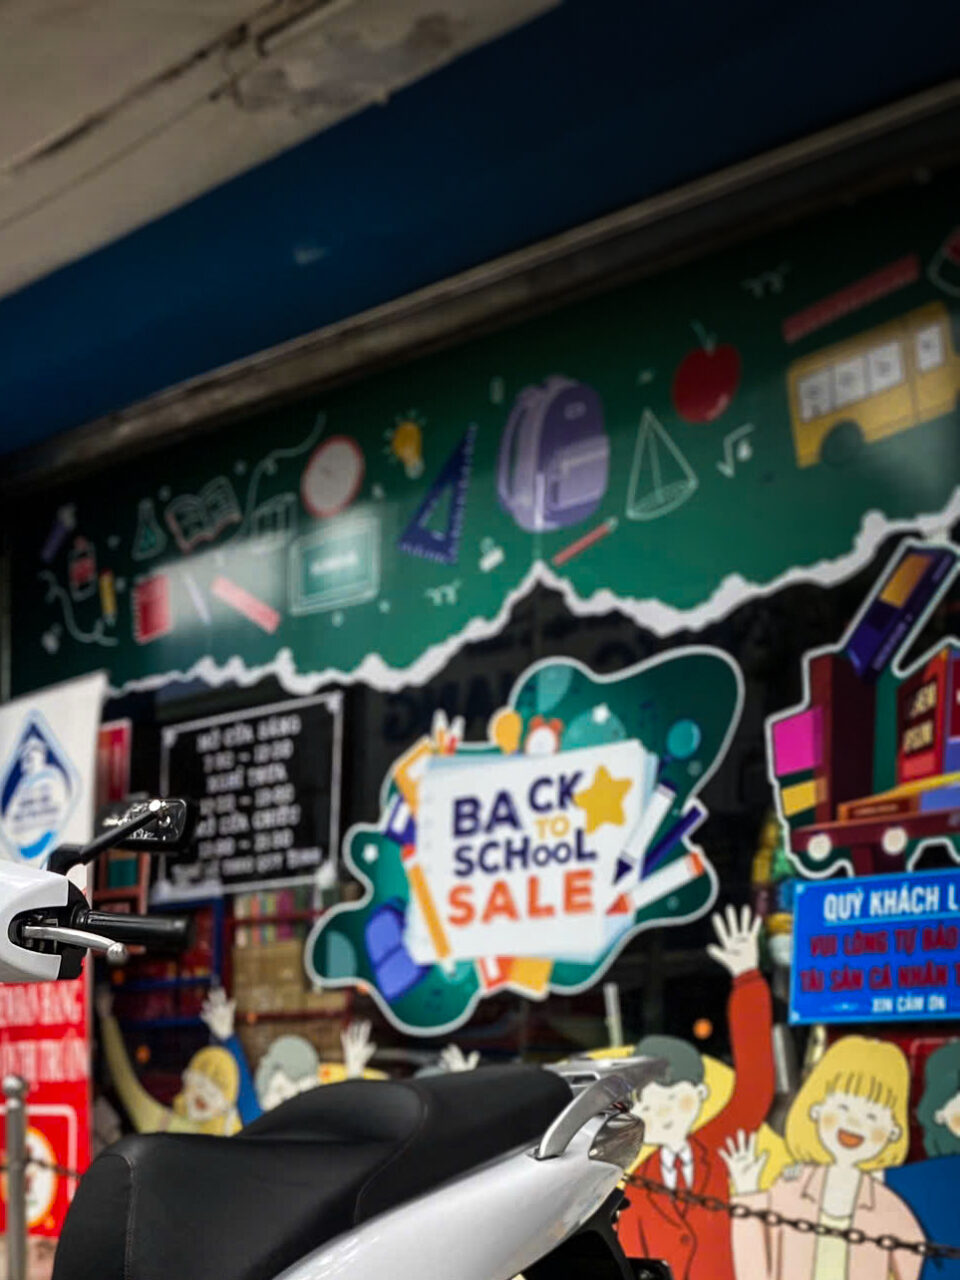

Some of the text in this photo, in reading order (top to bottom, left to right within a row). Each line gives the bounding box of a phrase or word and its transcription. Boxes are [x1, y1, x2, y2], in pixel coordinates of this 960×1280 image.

[452, 771, 583, 838] BACK
[535, 815, 570, 839] TO
[447, 868, 594, 927] SALE
[869, 882, 940, 917] KHÁCH
